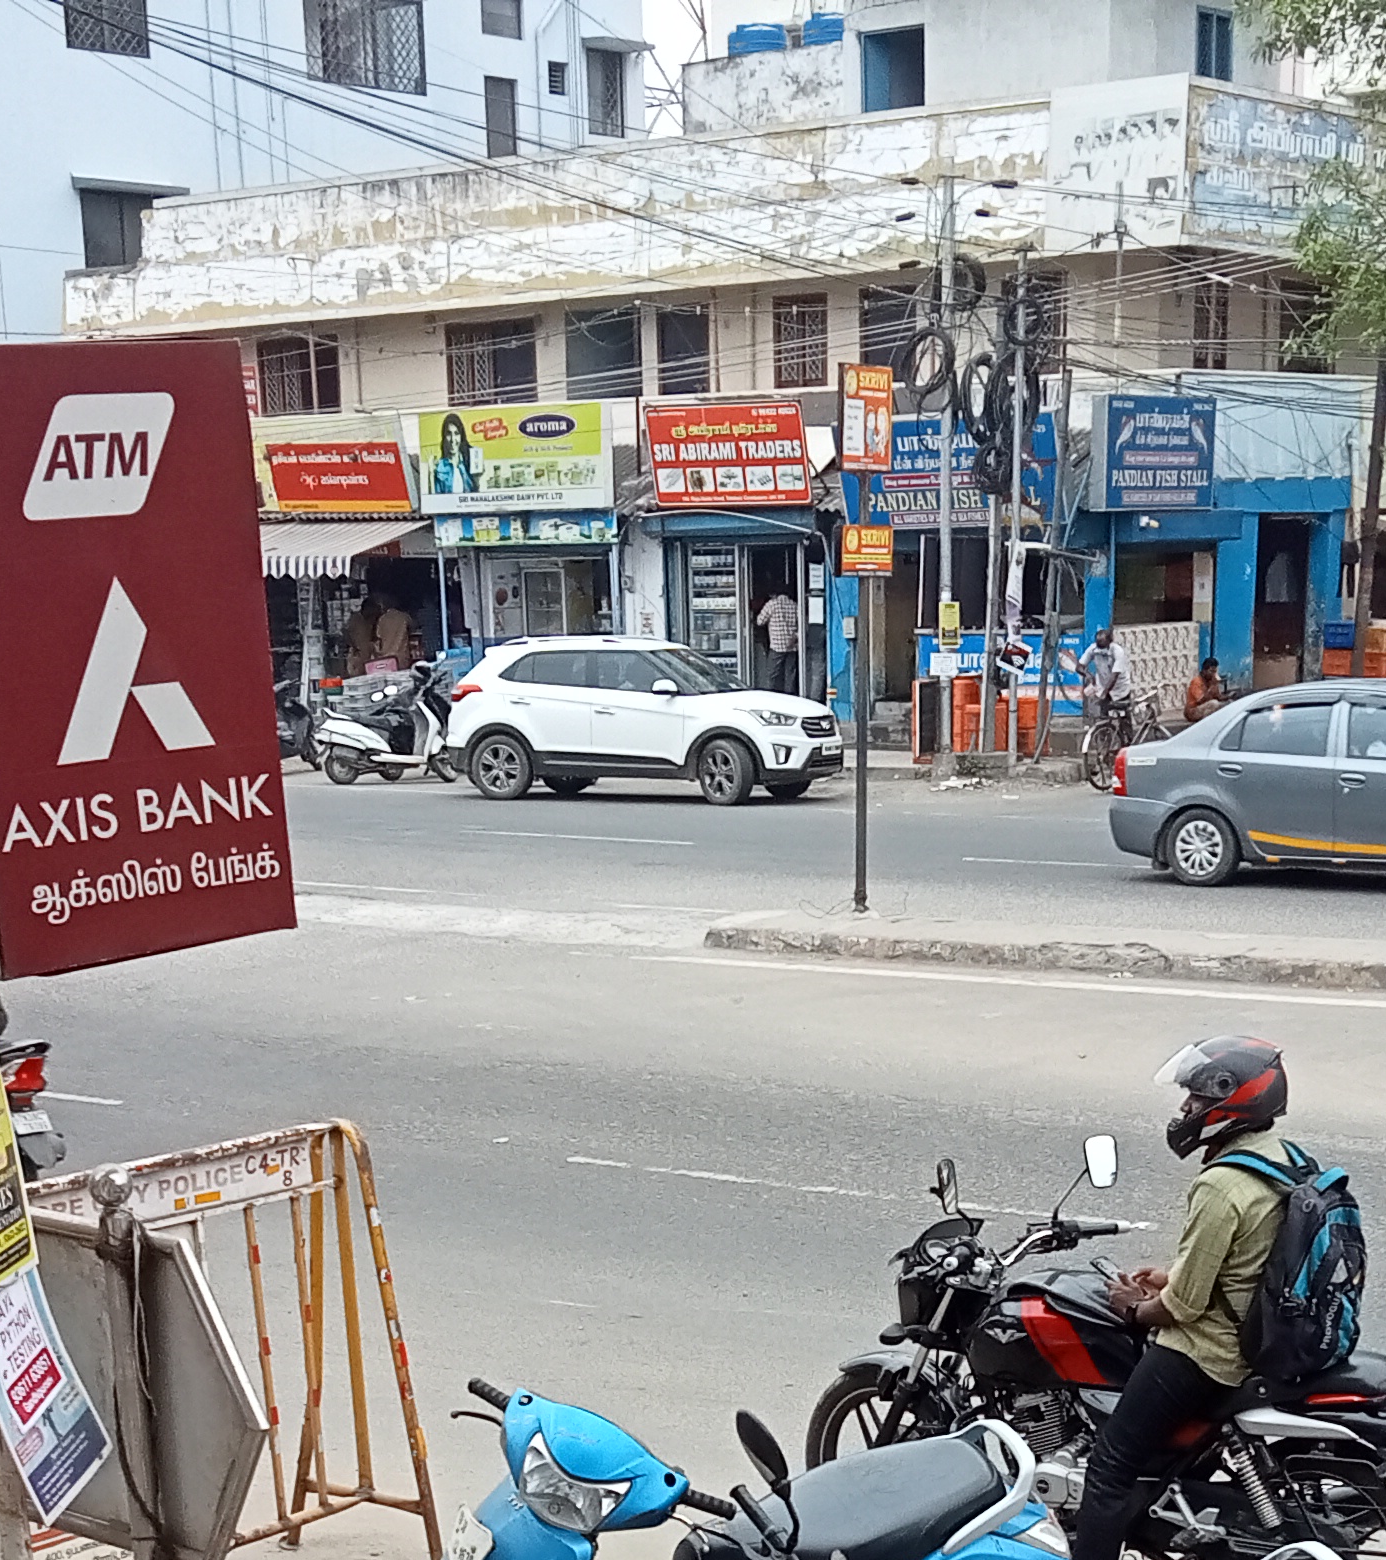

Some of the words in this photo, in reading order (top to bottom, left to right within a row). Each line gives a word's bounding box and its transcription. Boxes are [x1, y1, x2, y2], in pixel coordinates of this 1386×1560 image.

[526, 420, 567, 432] aroma
[44, 432, 151, 482] ATM
[653, 443, 675, 462] SRI
[679, 441, 737, 460] ABIRAMI
[739, 439, 802, 459] TRADERS
[320, 472, 369, 490] asianpaints
[1112, 469, 1154, 487] PANDIAN
[1156, 469, 1178, 487] FISH
[1180, 469, 1209, 486] STALL
[869, 491, 938, 513] PANDIAN
[2, 792, 119, 853] AXIS
[136, 773, 274, 834] BANK
[31, 856, 182, 925] ஆக்ஸிஸ்
[191, 842, 281, 889] பேங்க்
[159, 1163, 245, 1199] POLICE
[282, 1170, 293, 1187] 8
[0, 1305, 33, 1348] PYTHON
[6, 1326, 43, 1374] TESTING
